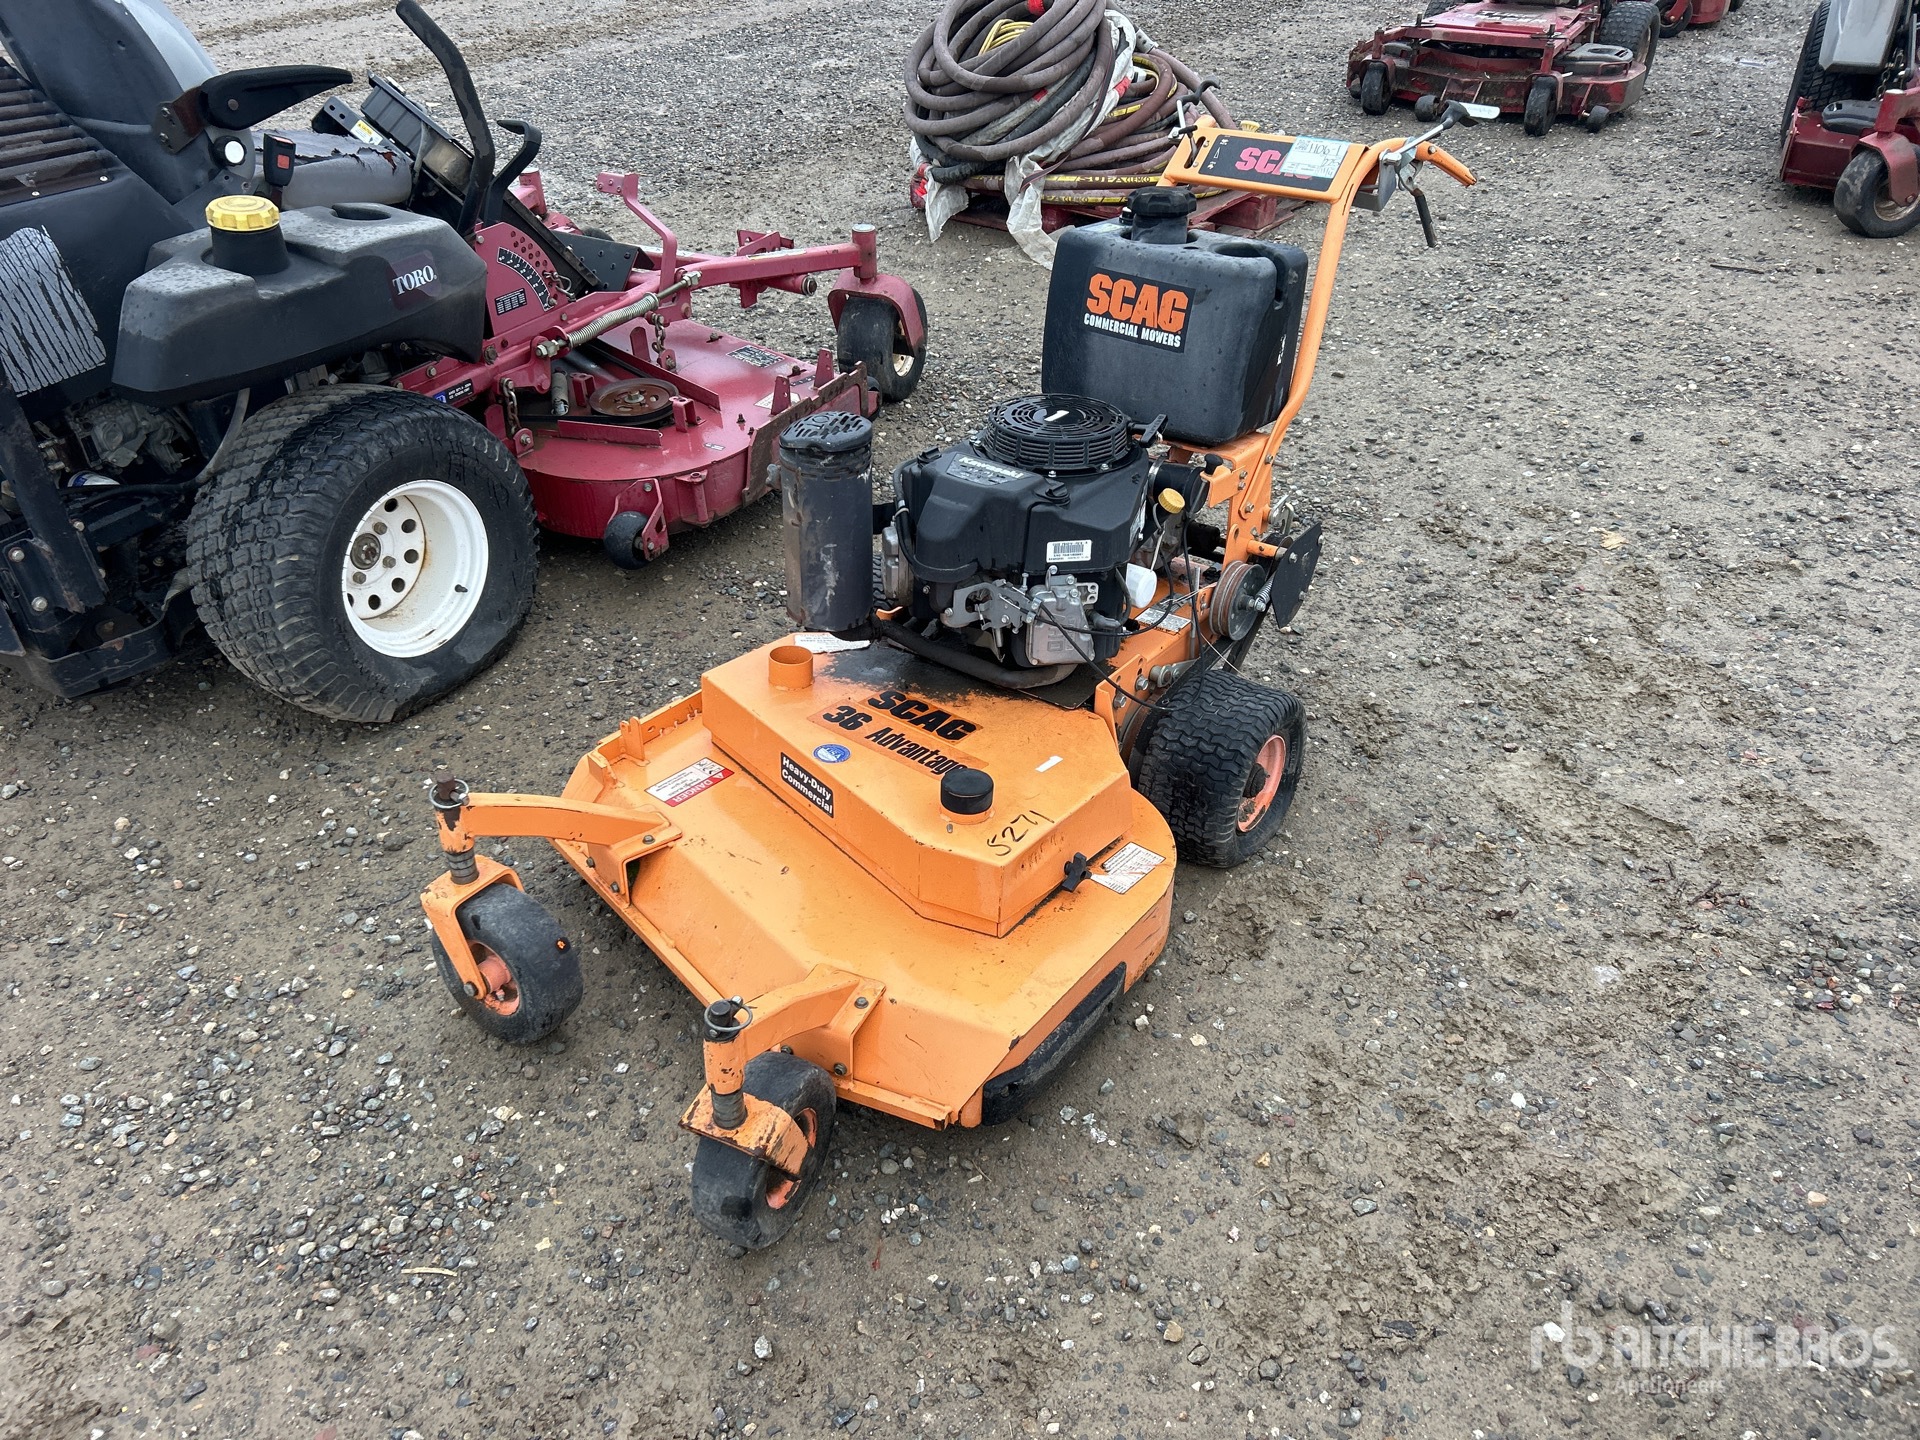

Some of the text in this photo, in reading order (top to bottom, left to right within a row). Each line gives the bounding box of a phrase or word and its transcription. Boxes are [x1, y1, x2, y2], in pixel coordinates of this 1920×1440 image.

[392, 265, 435, 296] TORO
[1086, 272, 1189, 333] SCAG
[1083, 312, 1182, 348] COMMERCIAL MOWERS
[822, 705, 873, 731] 36
[867, 690, 977, 741] SCAG
[672, 779, 714, 803] DANGER
[781, 768, 833, 814] Commercial
[782, 756, 832, 801] Heavy-Duty
[986, 810, 1055, 857] 5271
